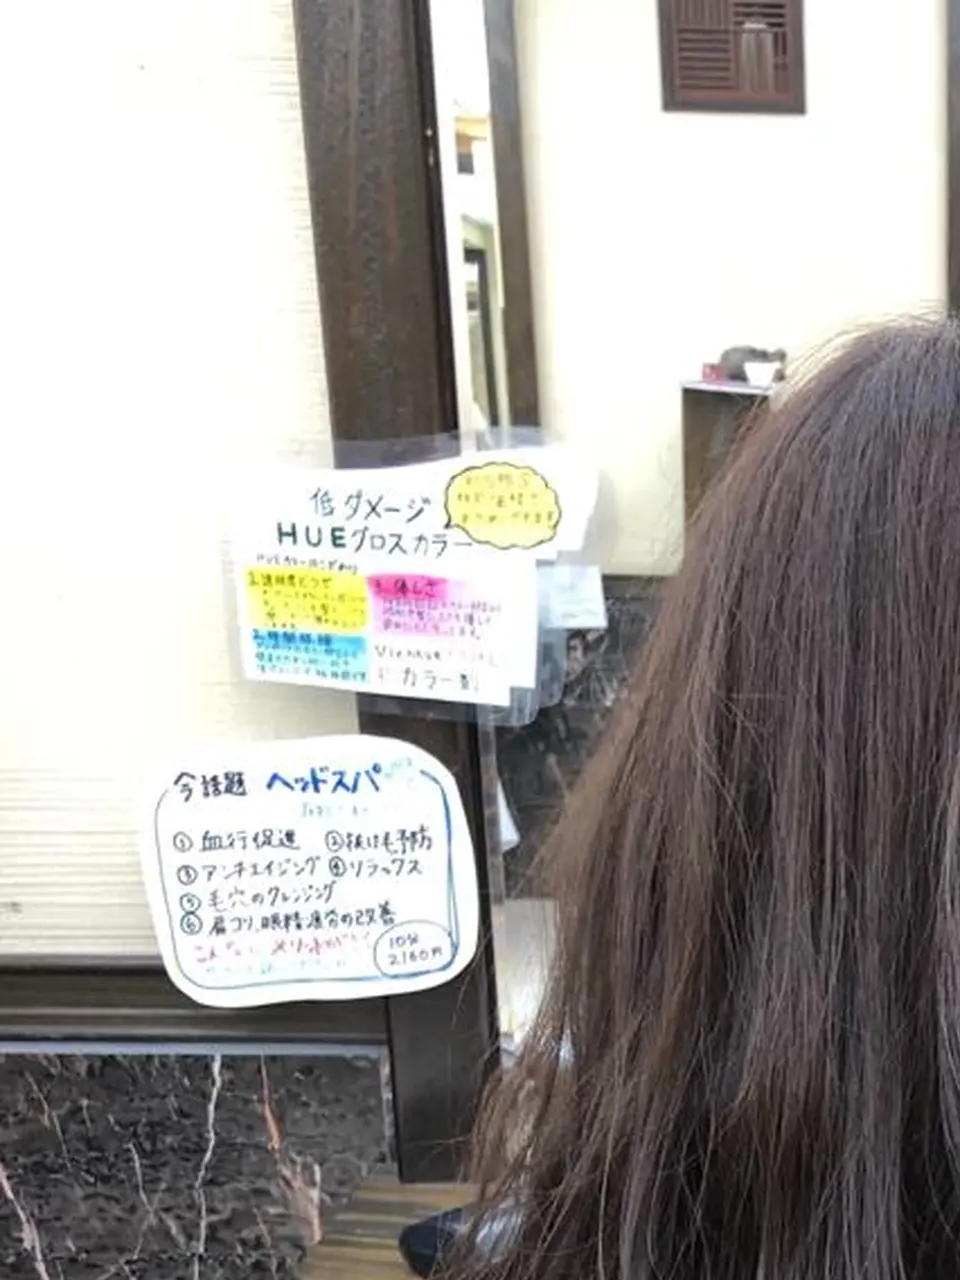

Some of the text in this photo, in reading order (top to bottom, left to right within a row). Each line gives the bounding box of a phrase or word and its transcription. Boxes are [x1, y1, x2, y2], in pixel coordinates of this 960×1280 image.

[309, 487, 432, 523] 低ダメージ
[173, 771, 248, 803] 今話題
[266, 762, 382, 794] ヘッドスパ
